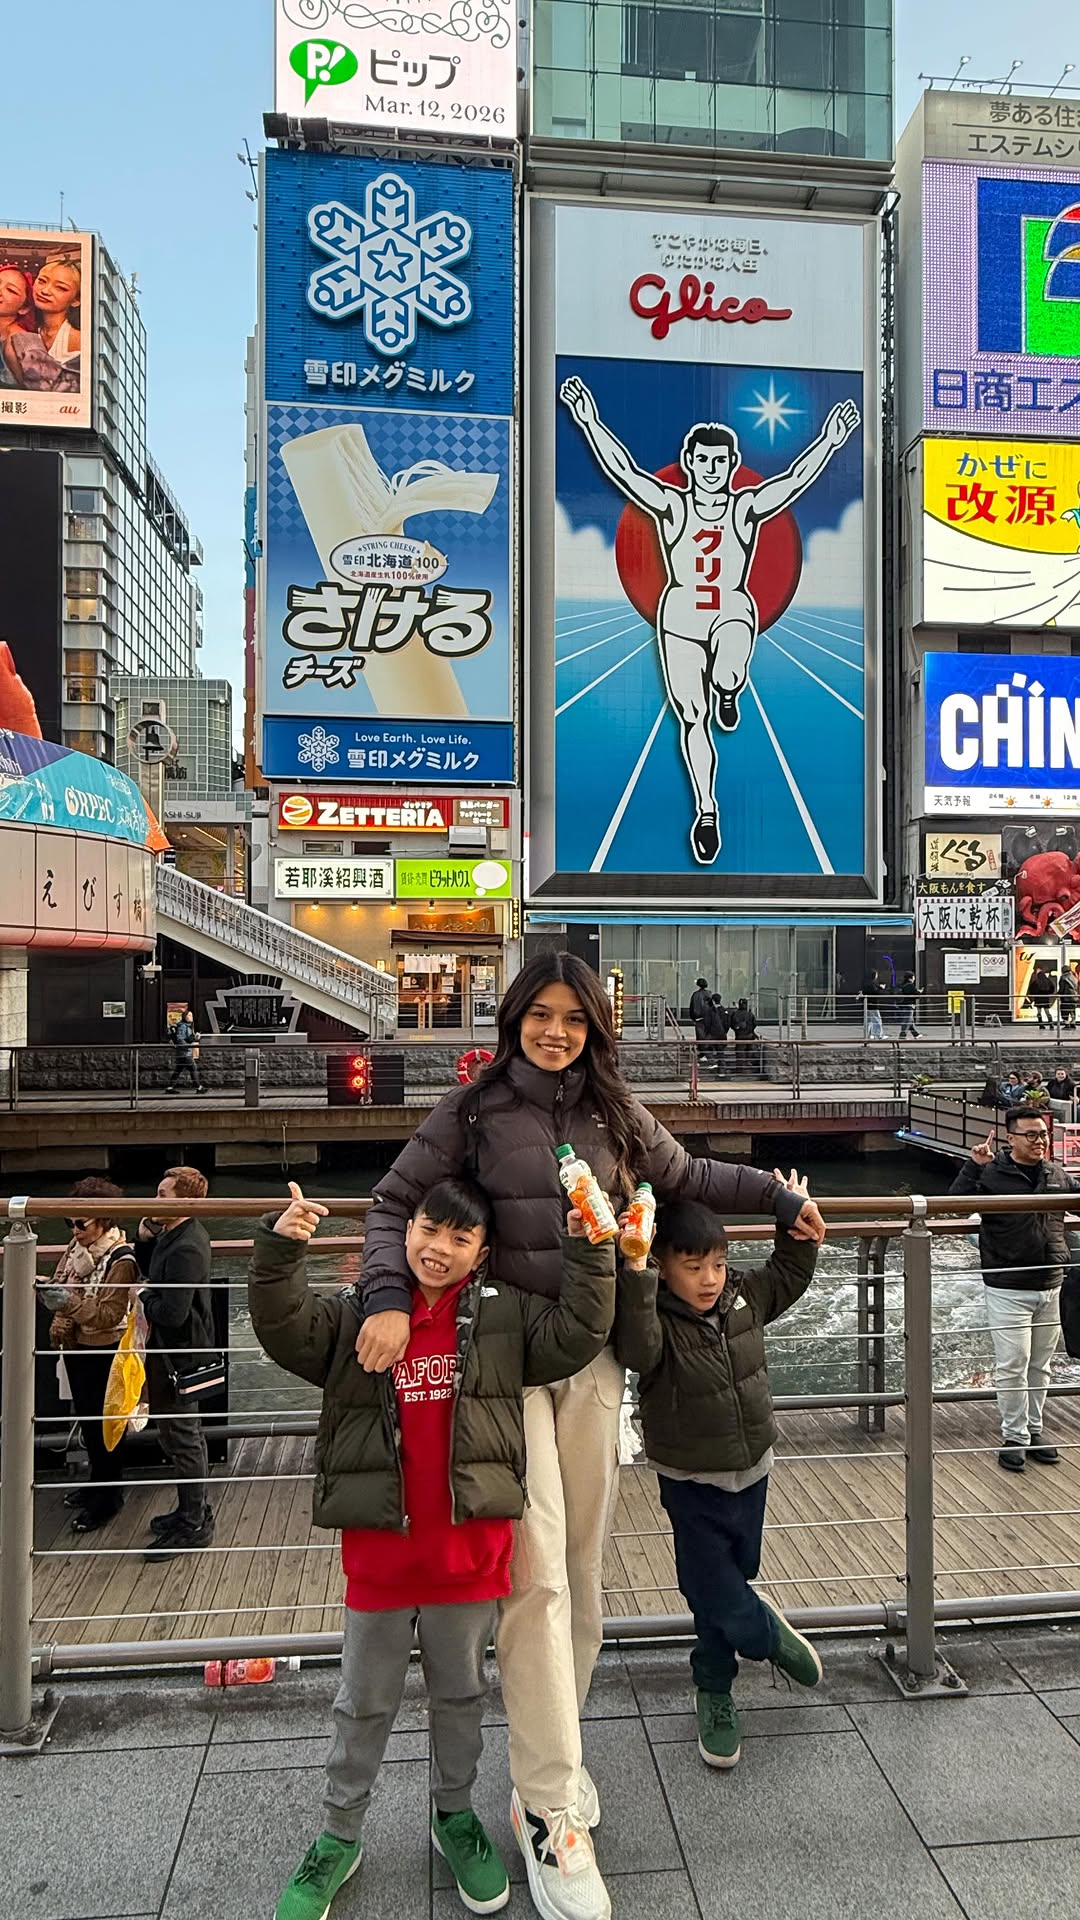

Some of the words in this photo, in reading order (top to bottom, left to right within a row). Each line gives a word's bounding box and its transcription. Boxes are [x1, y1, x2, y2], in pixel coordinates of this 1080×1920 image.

[370, 48, 461, 90] ピップ
[365, 94, 413, 117] Mar.
[417, 99, 446, 121] 12,
[450, 102, 506, 125] 2026
[989, 100, 1080, 128] 夢ある住
[968, 133, 1080, 159] エステムシ
[629, 273, 793, 339] Glico
[304, 358, 476, 394] 雪印メグミルク
[59, 404, 80, 415] au
[956, 452, 1048, 480] かぜに
[945, 481, 1057, 526] 改源
[361, 541, 388, 552] STRING
[389, 541, 417, 554] CHEESE
[692, 525, 724, 610] グリコ
[284, 583, 491, 655] さける
[284, 655, 363, 688] チーズ
[355, 732, 380, 742] Love
[383, 733, 417, 744] Earth.
[421, 734, 446, 744] Love
[448, 734, 472, 745] Life.
[347, 747, 480, 771] 雪印メグミルク
[318, 801, 445, 827] ZETTERIA
[934, 795, 971, 807] 天気予報
[940, 839, 987, 872] くくる
[429, 869, 471, 888] ピタットハウス
[918, 882, 986, 895] 大阪もんを食す
[922, 904, 1000, 932] 大阪に乾杯
[392, 1354, 457, 1390] AFOR
[404, 1391, 428, 1402] EST.
[429, 1388, 453, 1400] 1922
